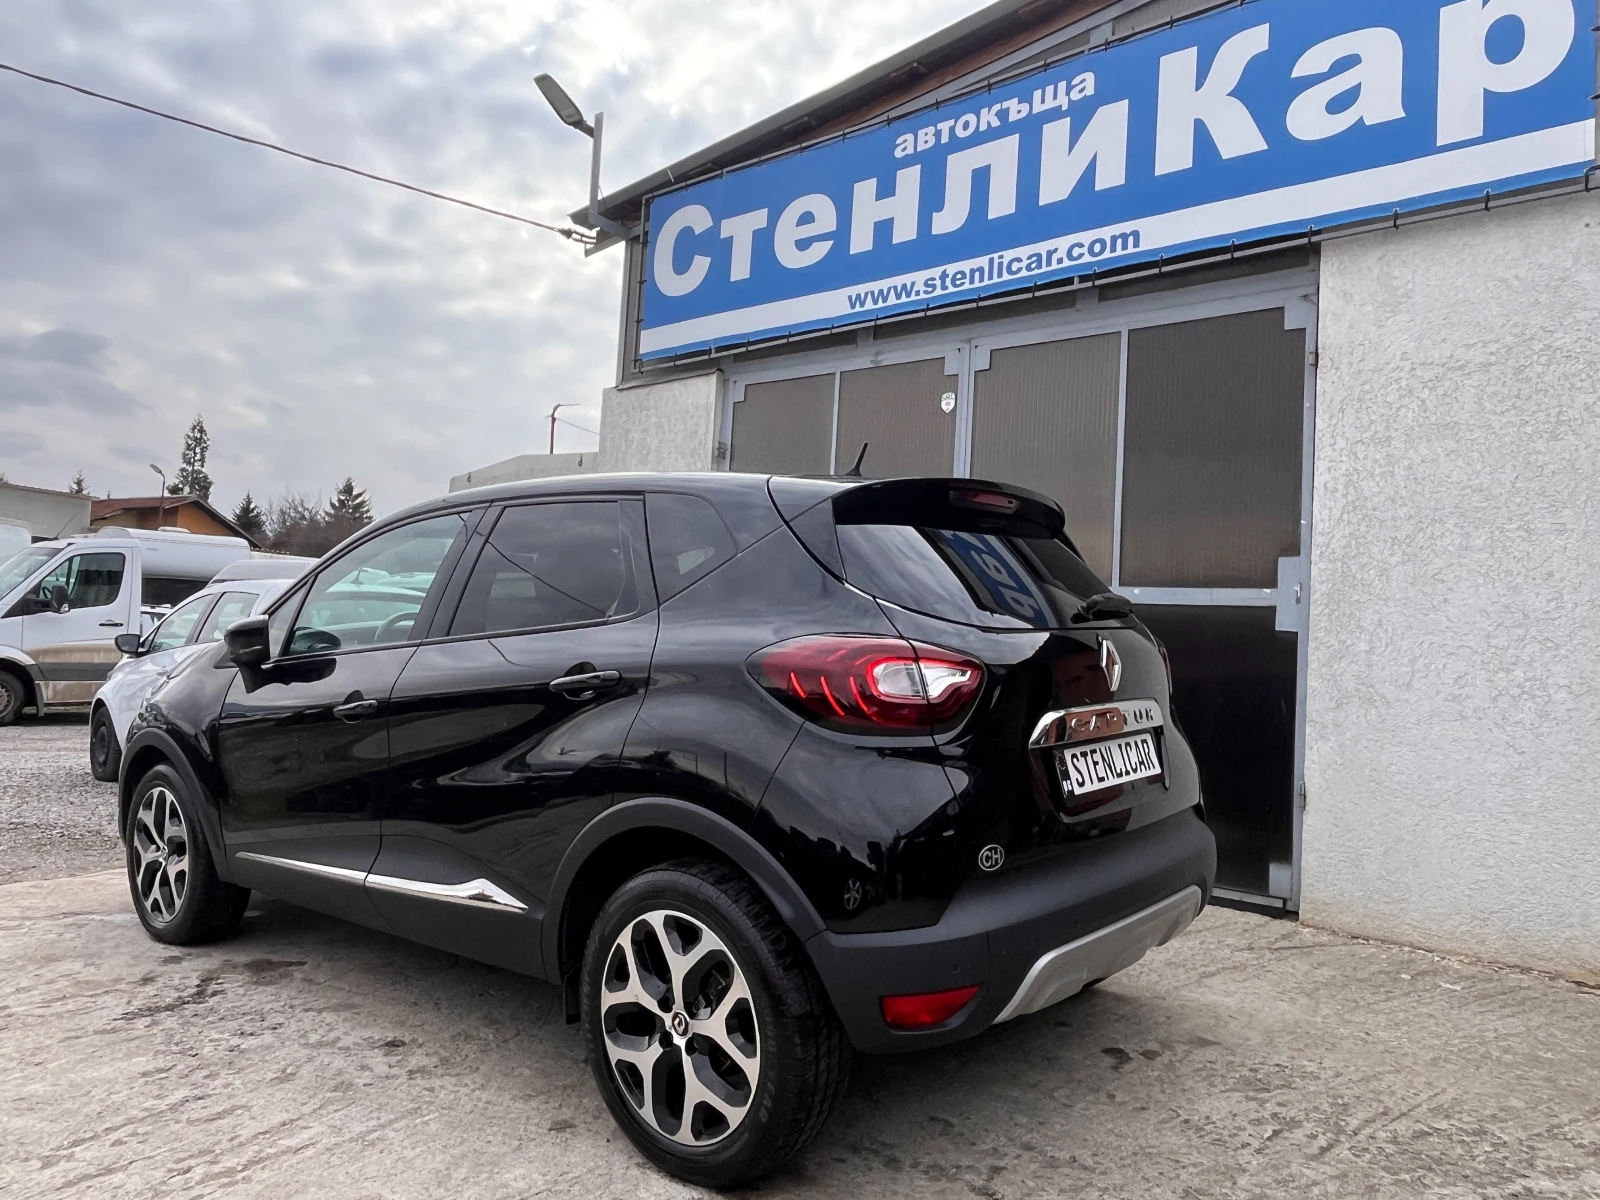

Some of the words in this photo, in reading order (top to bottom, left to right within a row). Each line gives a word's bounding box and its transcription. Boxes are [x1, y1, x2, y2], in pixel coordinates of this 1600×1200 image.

[652, 0, 1575, 297] СтенлиКар
[894, 71, 1095, 158] автокъща
[848, 229, 1140, 309] www.stenlicar.com
[1070, 738, 1156, 788] STENLICAR
[982, 848, 1001, 867] CH
